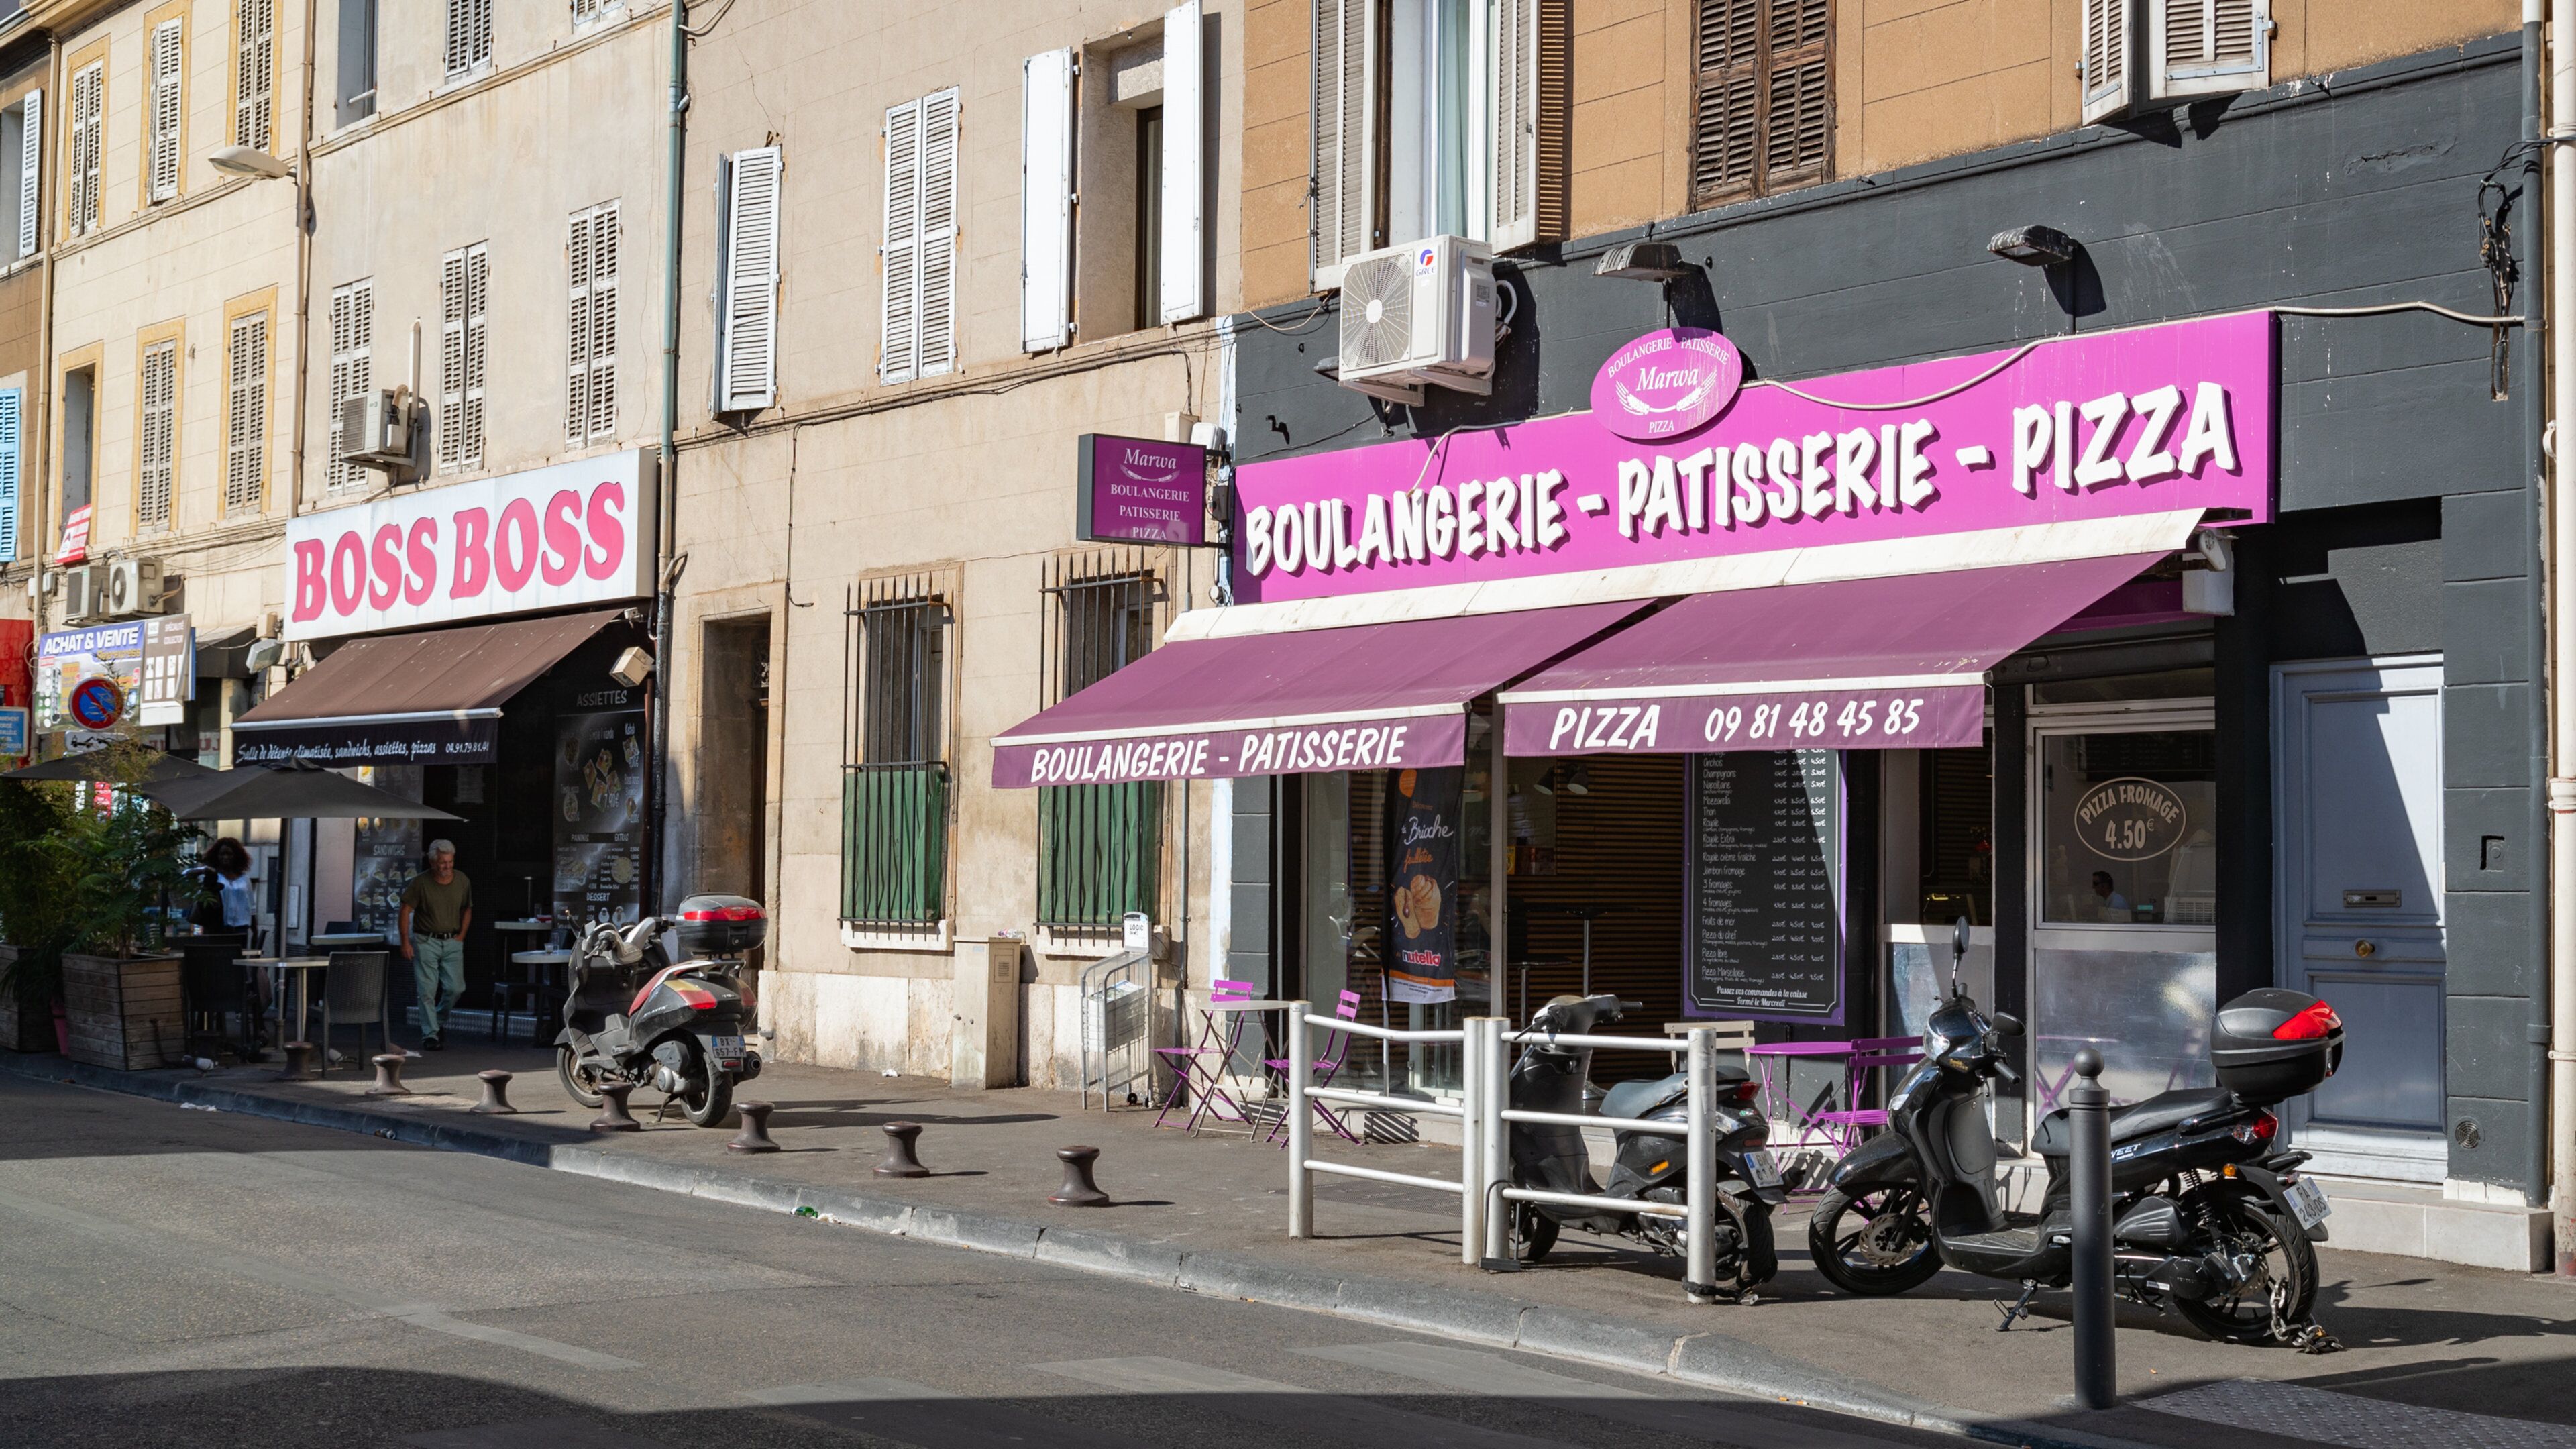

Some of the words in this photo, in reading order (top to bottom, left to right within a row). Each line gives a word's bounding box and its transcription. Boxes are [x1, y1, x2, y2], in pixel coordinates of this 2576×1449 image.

[1607, 337, 1672, 378] BOULANGERIE
[1681, 337, 1729, 366] PATISSERIE
[1635, 366, 1699, 391] Marwa
[1648, 420, 1674, 433] PIZZA
[1124, 448, 1176, 469] Marwa
[1246, 468, 1567, 577] BOULANGERIE
[1617, 418, 1937, 538] PATISSERIE
[2012, 381, 2236, 494] PIZZA
[1110, 484, 1189, 502] BOULANGERIE
[1120, 505, 1180, 521] PATISSERIE
[1132, 527, 1167, 540] PIZZA
[292, 517, 438, 623] BOSS
[450, 482, 625, 600] BOSS
[44, 634, 85, 655] ACHAT
[84, 633, 94, 650] &
[96, 627, 139, 649] VENTE
[576, 690, 627, 706] ASSIETTES
[1549, 704, 1660, 750] PIZZA
[1704, 706, 1742, 743] 09
[1749, 704, 1780, 738] 81
[1788, 700, 1829, 738] 48
[1837, 698, 1877, 737] 45
[1884, 698, 1924, 735] 85
[236, 743, 258, 763] Salle
[411, 740, 436, 760] pizzas
[1030, 739, 1209, 783] BOULANGERIE
[1238, 726, 1407, 772] PATISSERIE
[1703, 806, 1716, 816] Thon
[2080, 788, 2116, 825] PIZZA
[2119, 784, 2180, 824] FROMAGE
[1403, 814, 1454, 845] Brioche
[1720, 833, 1735, 843] Extra
[1703, 865, 1723, 875] Jambon
[1703, 879, 1707, 889] 3
[586, 892, 610, 901] DESSERT
[1703, 898, 1707, 907] 4
[1702, 916, 1716, 926] Fruits
[1717, 917, 1723, 926] de
[1702, 929, 1717, 939] Pizza
[1717, 930, 1724, 939] du
[1725, 930, 1737, 939] chef
[1402, 950, 1441, 967] nutella
[1702, 948, 1716, 958] Pizza
[1702, 966, 1716, 976] Pizza
[1716, 985, 1734, 995] Passez
[1744, 987, 1777, 996] commandes
[1778, 988, 1782, 997] à
[1783, 989, 1789, 998] la
[1790, 989, 1808, 999] caisse
[1736, 996, 1754, 1006] Fermé
[1754, 997, 1760, 1006] le
[1761, 997, 1786, 1007] Mercredi
